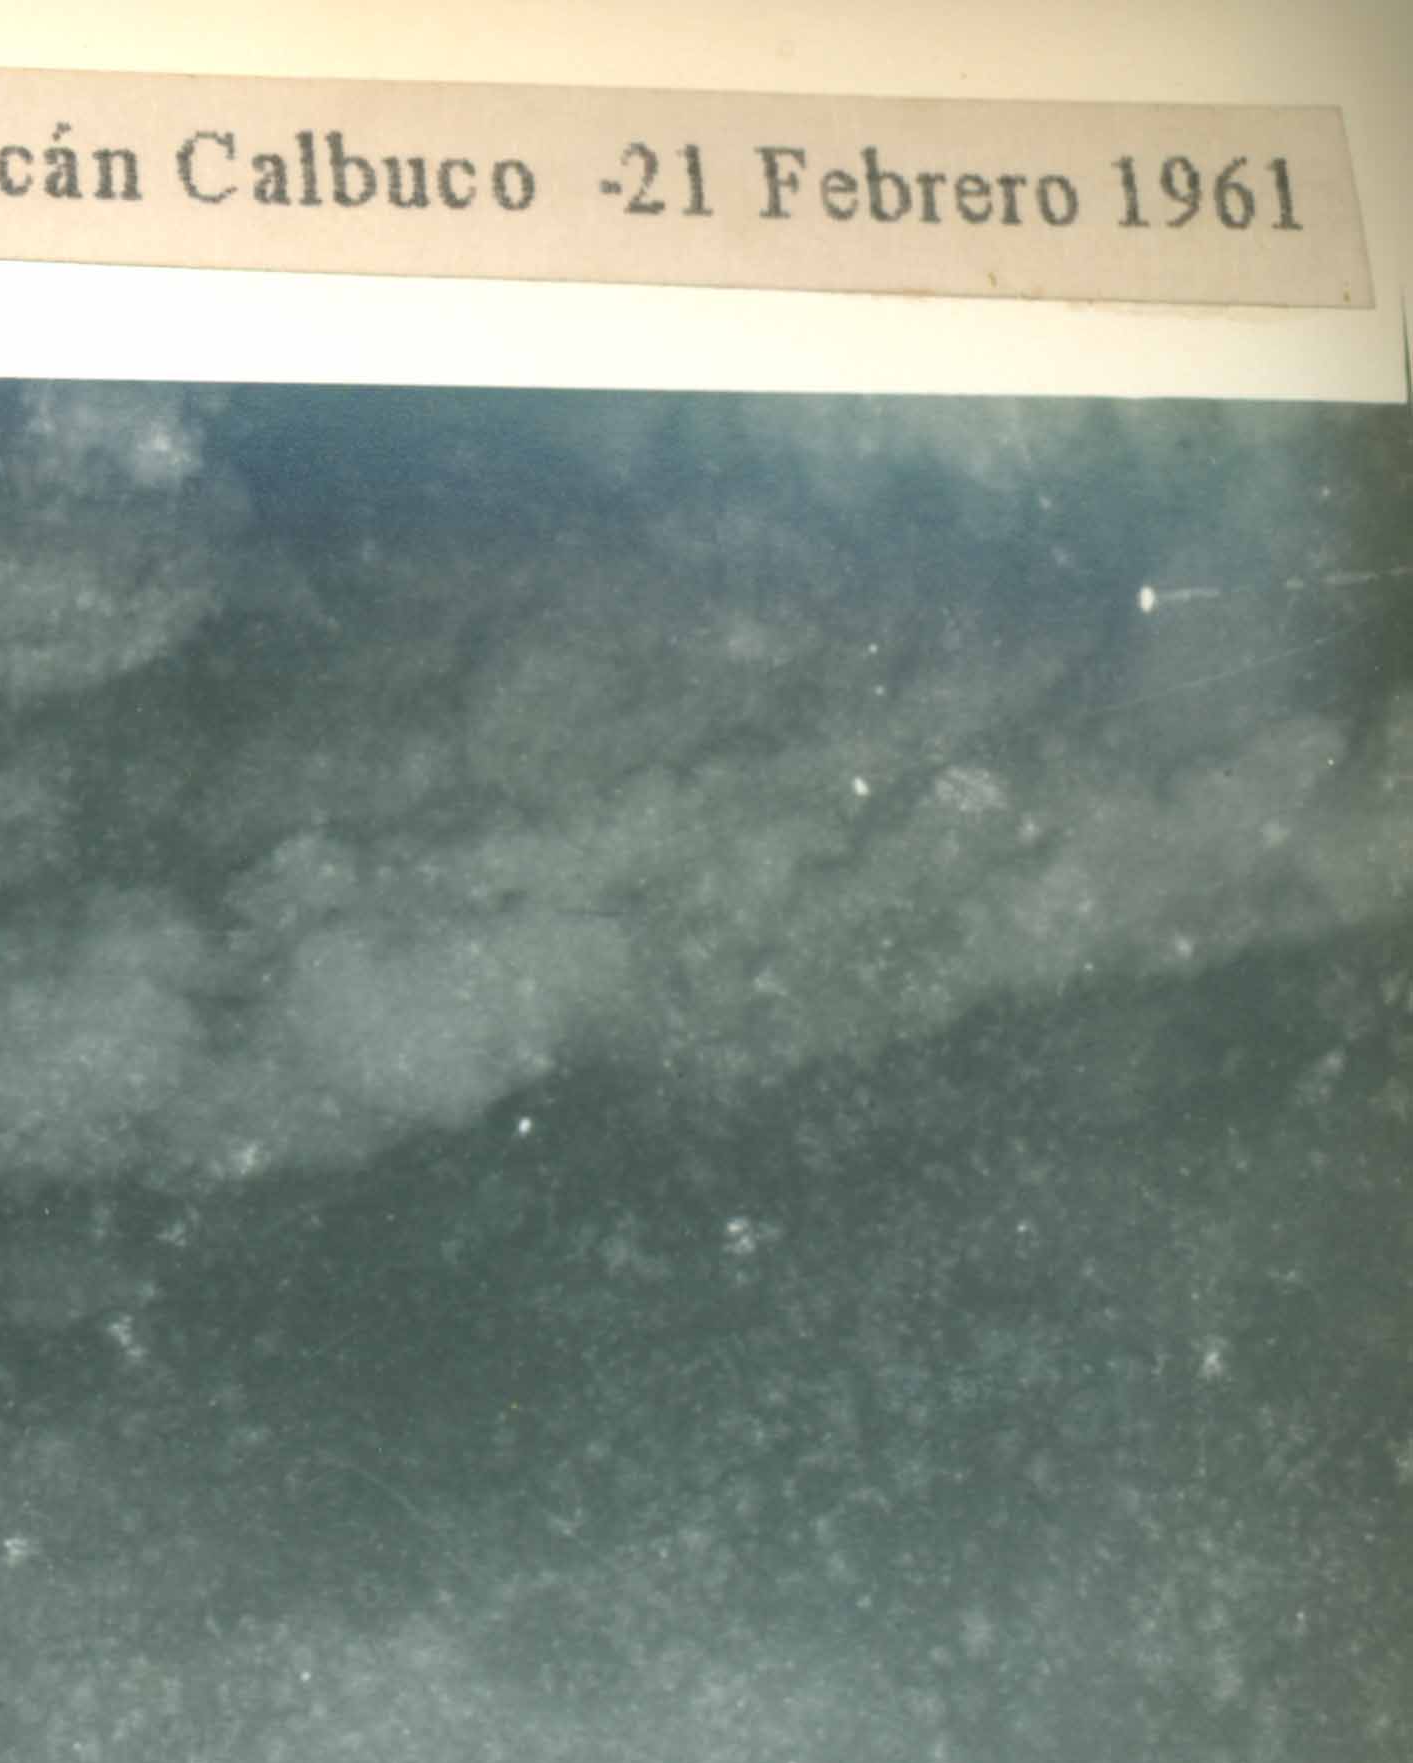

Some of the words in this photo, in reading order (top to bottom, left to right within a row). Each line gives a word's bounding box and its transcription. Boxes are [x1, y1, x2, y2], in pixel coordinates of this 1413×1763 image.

[175, 130, 536, 212] Calbuco
[600, 143, 714, 216] -21
[754, 146, 1080, 227] Febrero
[1113, 156, 1304, 231] 1961
